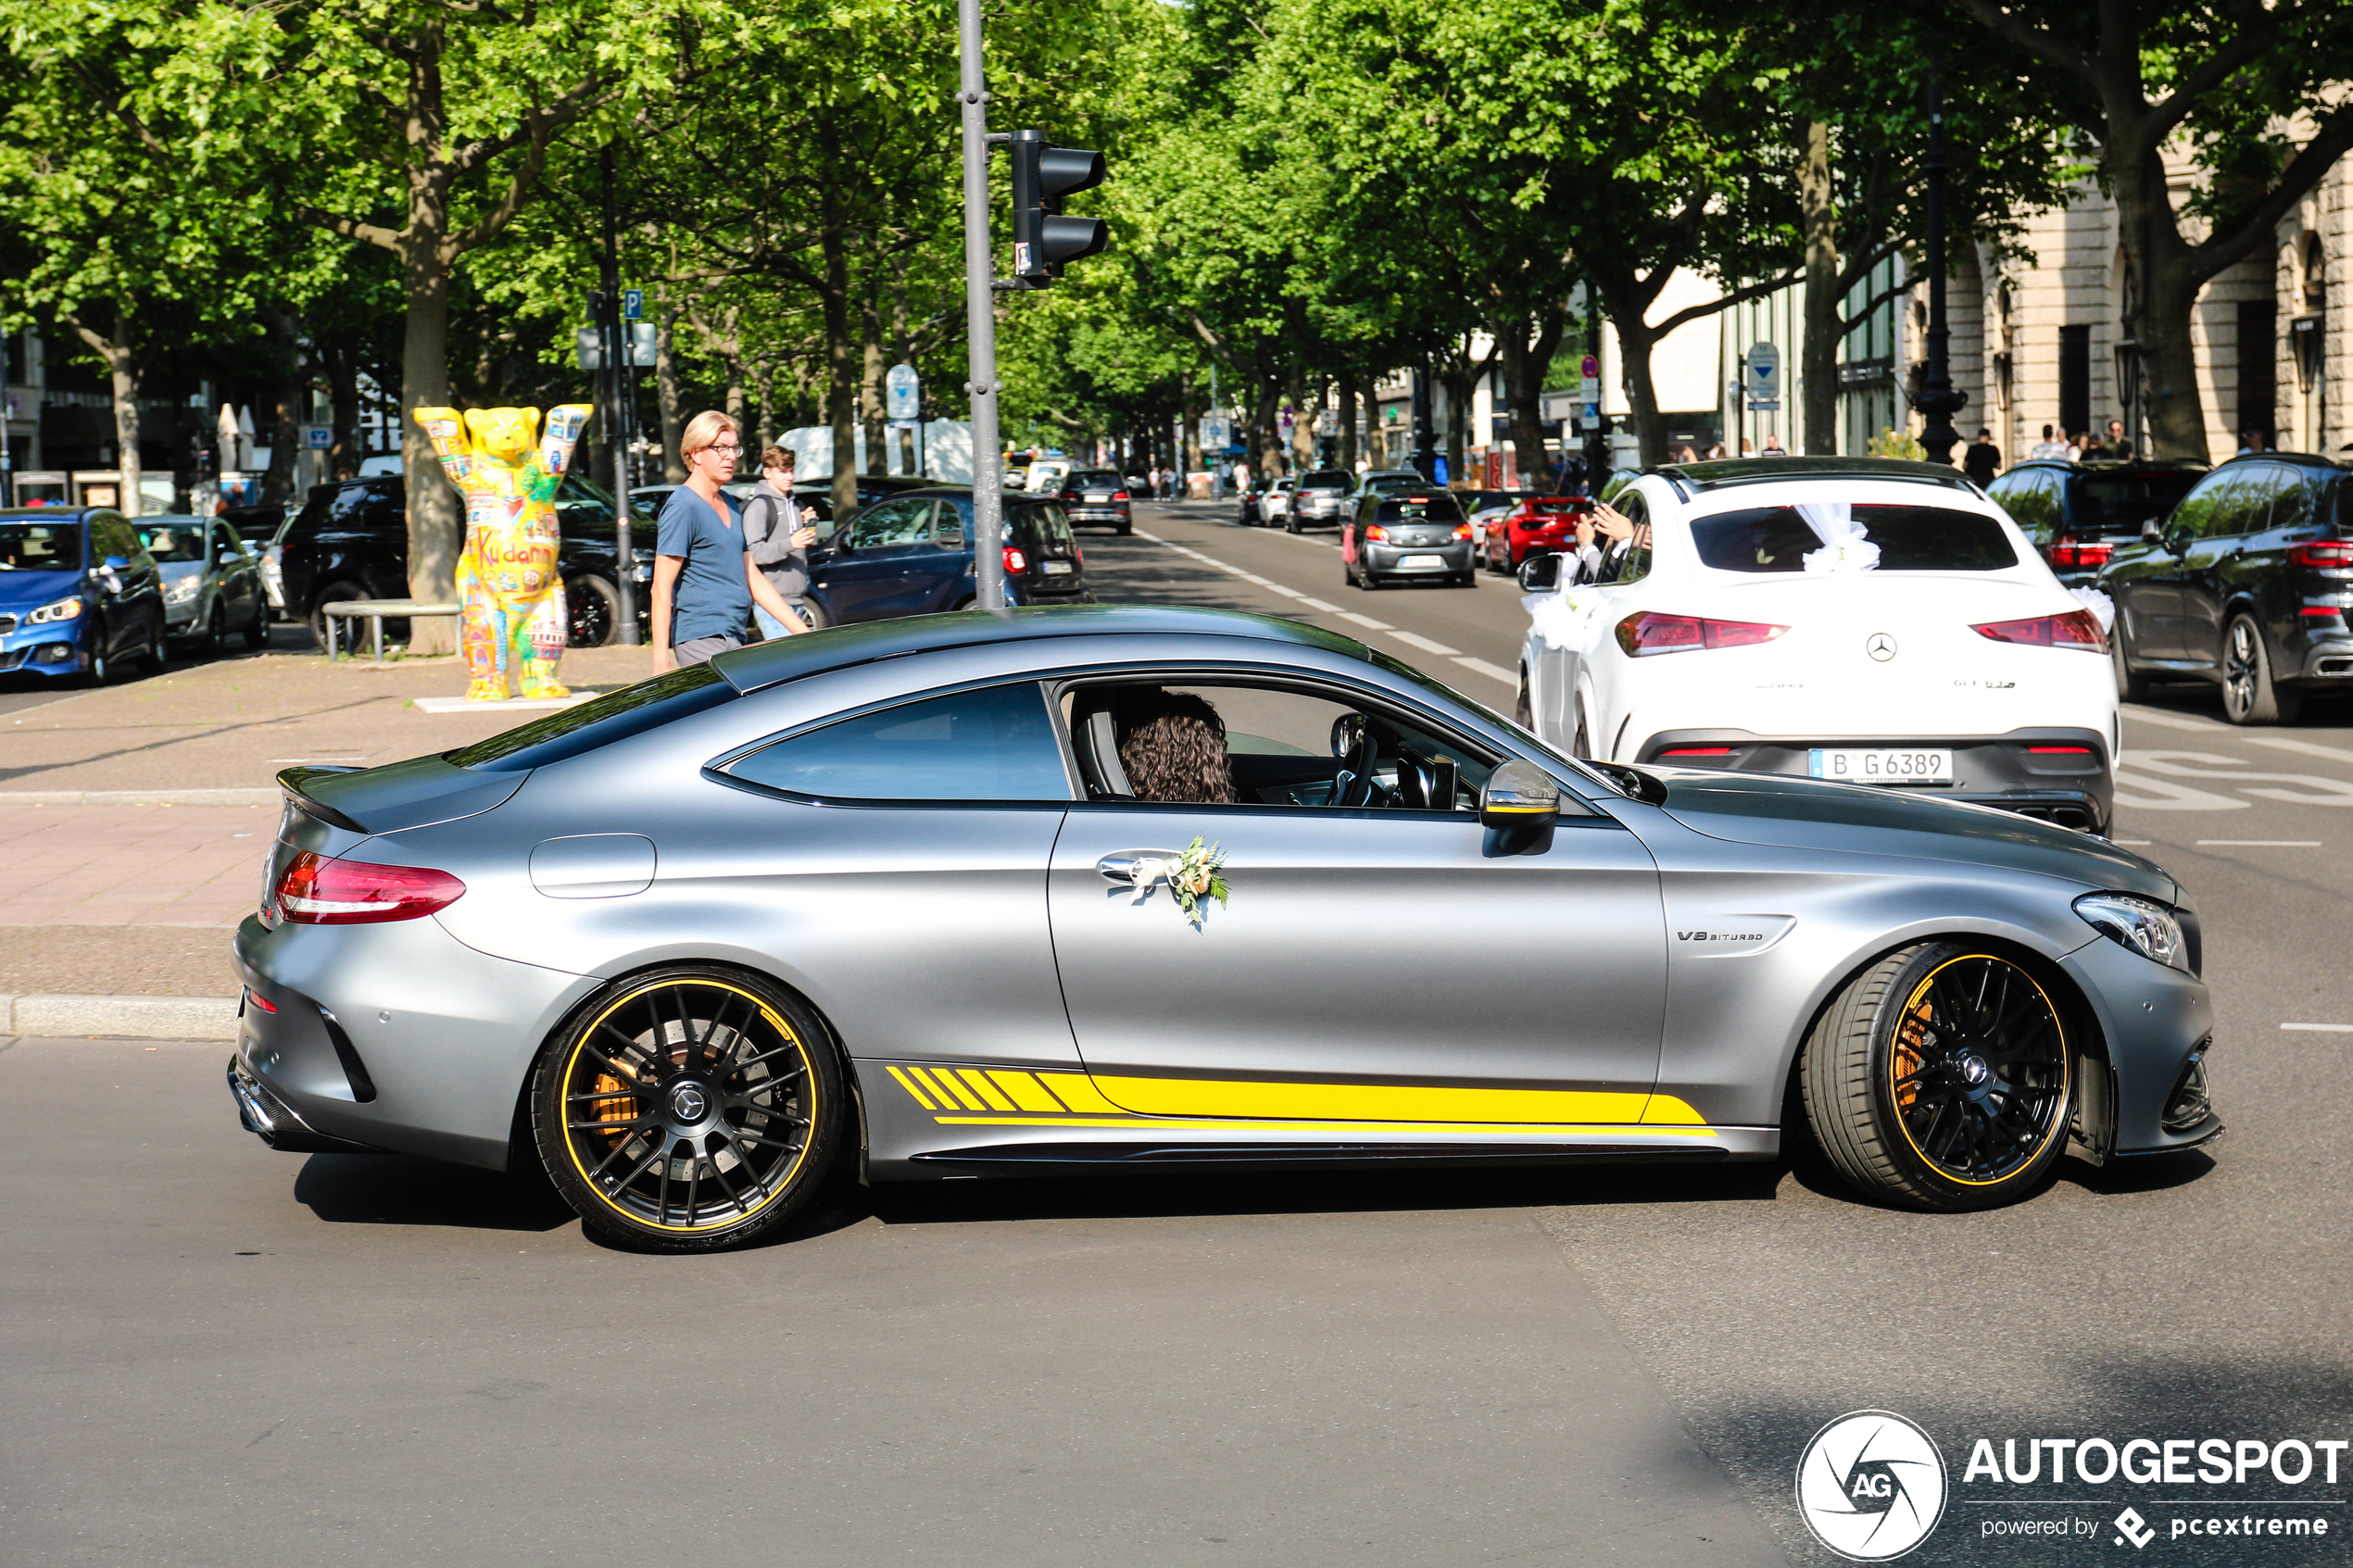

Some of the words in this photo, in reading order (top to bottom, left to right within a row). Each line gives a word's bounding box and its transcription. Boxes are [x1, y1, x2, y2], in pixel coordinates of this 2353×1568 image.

[627, 293, 638, 315] P
[1833, 754, 1847, 774] B
[1865, 754, 1879, 774] G
[1886, 754, 1942, 774] 6389
[1678, 931, 1707, 941] V8
